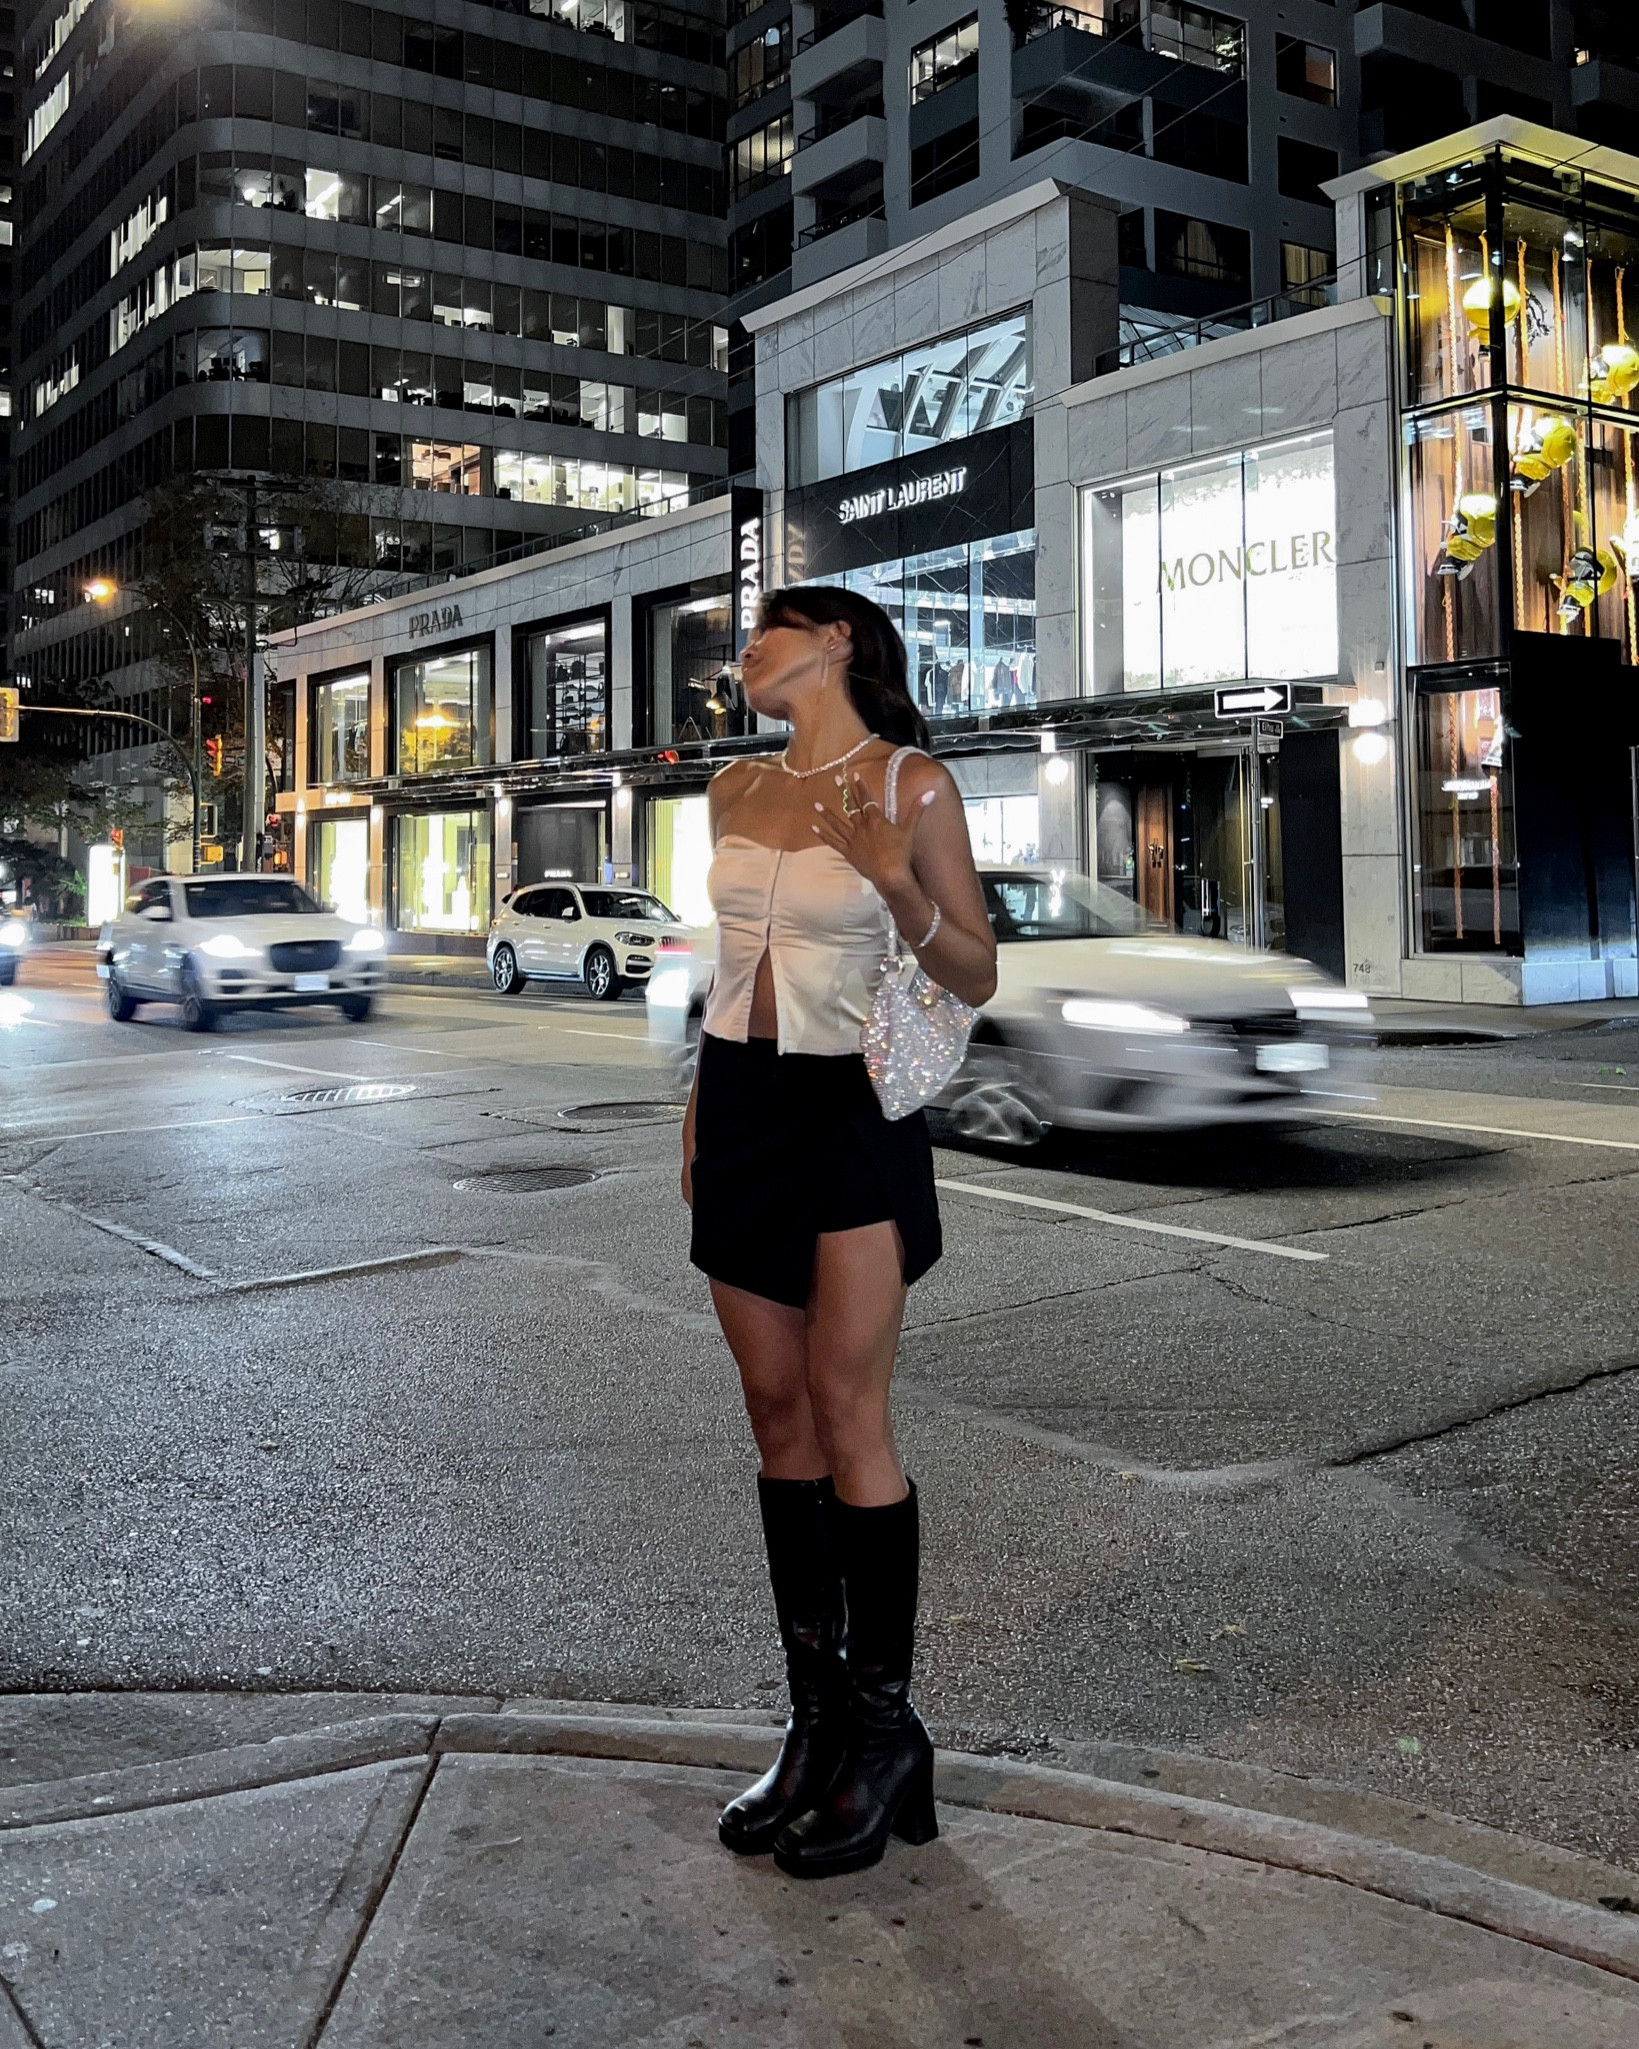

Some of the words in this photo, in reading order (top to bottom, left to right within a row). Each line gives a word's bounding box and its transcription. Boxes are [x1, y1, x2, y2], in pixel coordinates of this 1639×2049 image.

[838, 489, 885, 525] SAINT
[887, 466, 967, 511] LAURENT
[740, 517, 761, 630] PRADA
[1156, 531, 1336, 593] MONCLER
[408, 604, 463, 639] PRADA
[1352, 962, 1371, 974] 748
